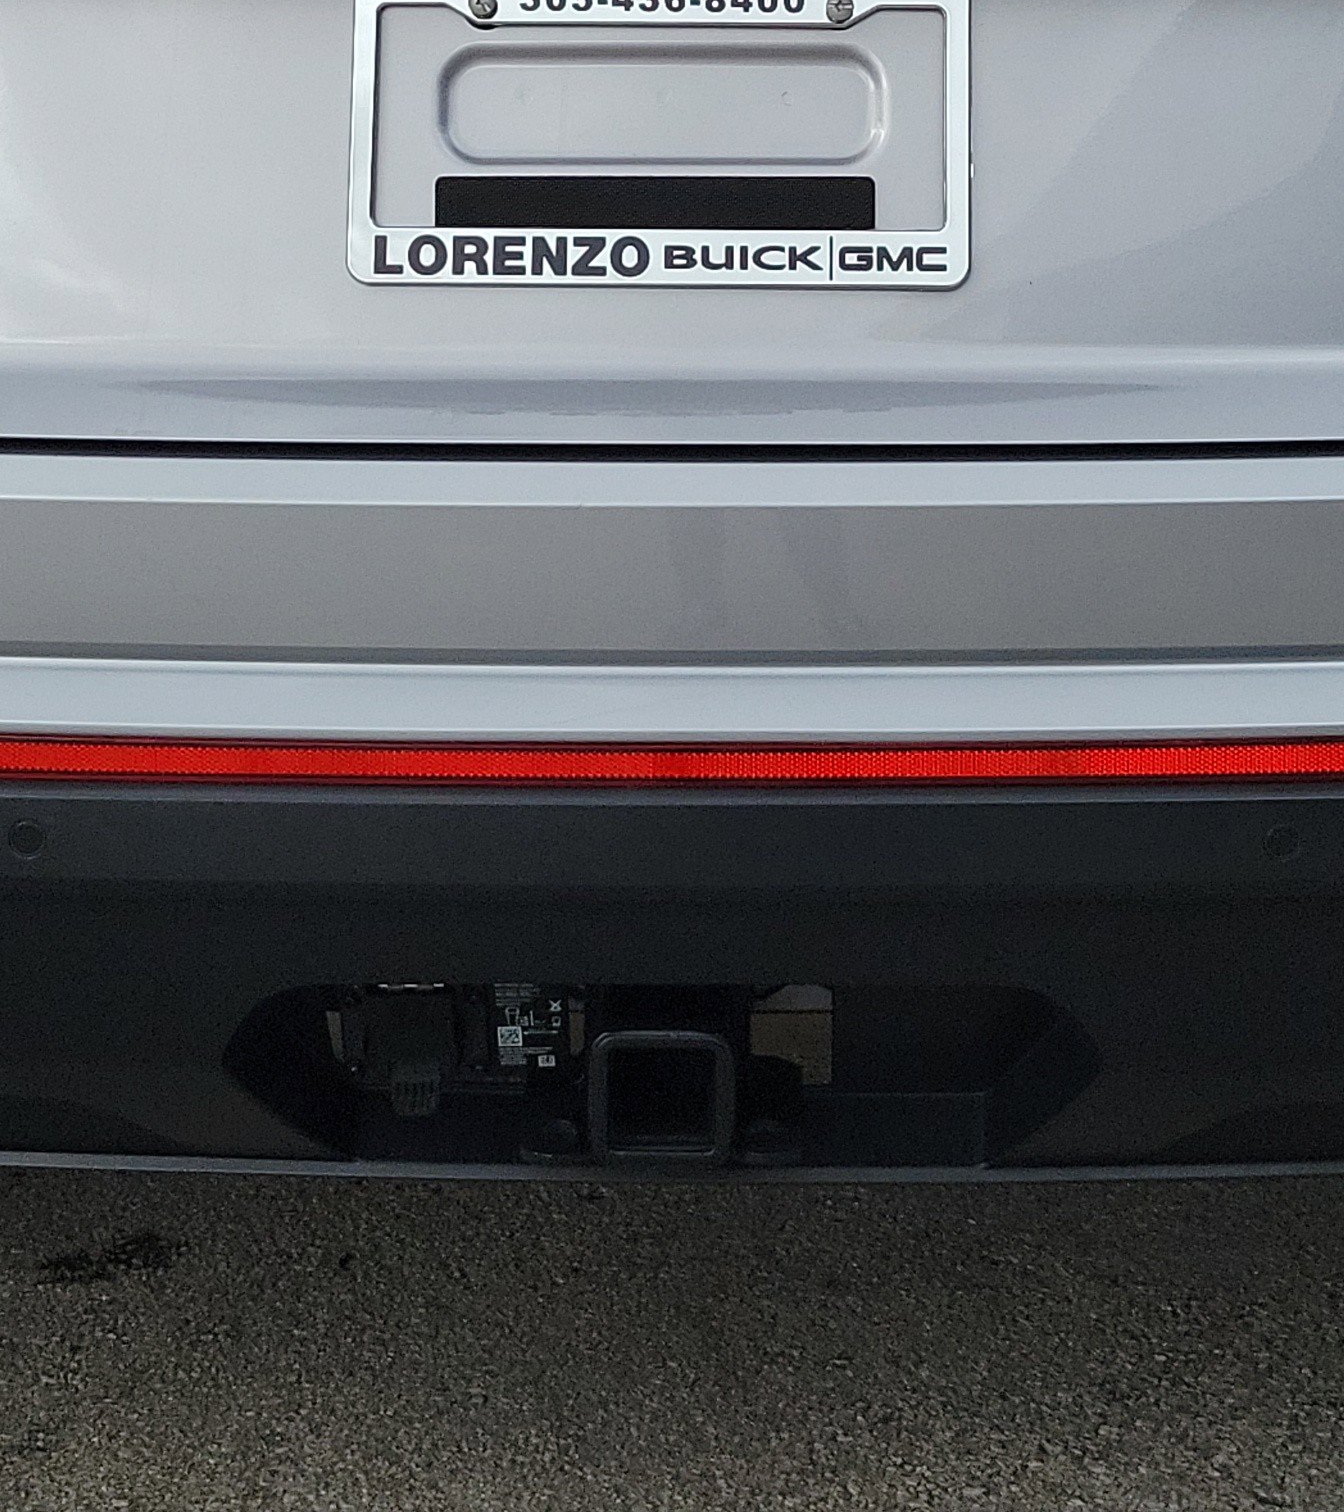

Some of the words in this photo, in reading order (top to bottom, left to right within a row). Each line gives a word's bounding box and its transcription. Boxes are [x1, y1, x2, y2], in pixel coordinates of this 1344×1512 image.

[372, 235, 651, 278] LORENZO
[662, 244, 824, 273] BUICK
[837, 244, 948, 273] GMC
